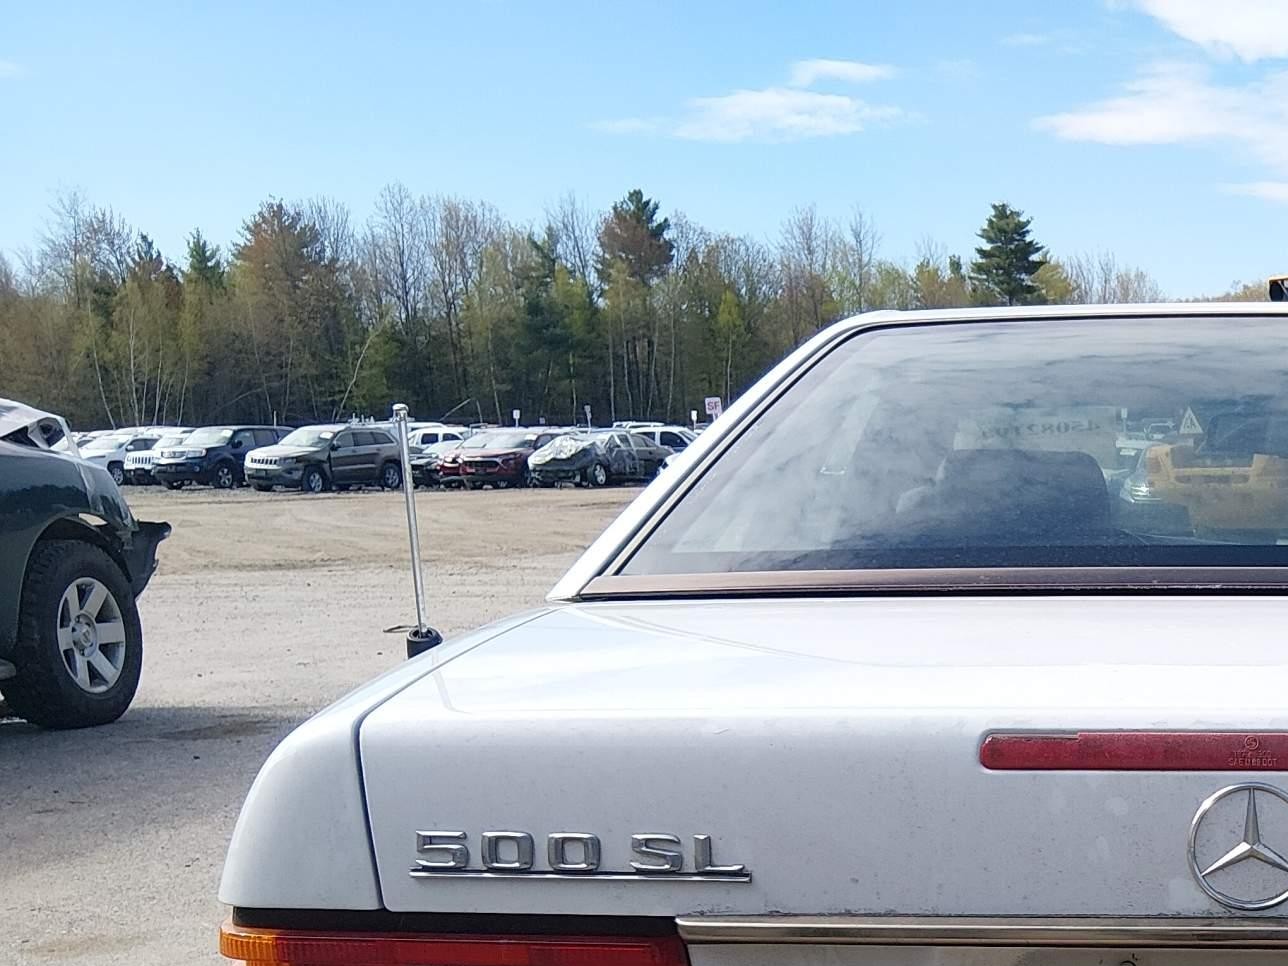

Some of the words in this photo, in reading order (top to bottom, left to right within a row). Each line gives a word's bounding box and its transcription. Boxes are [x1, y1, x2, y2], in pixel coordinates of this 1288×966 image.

[707, 401, 720, 411] SF
[415, 829, 602, 873] 500
[630, 832, 746, 873] SL
